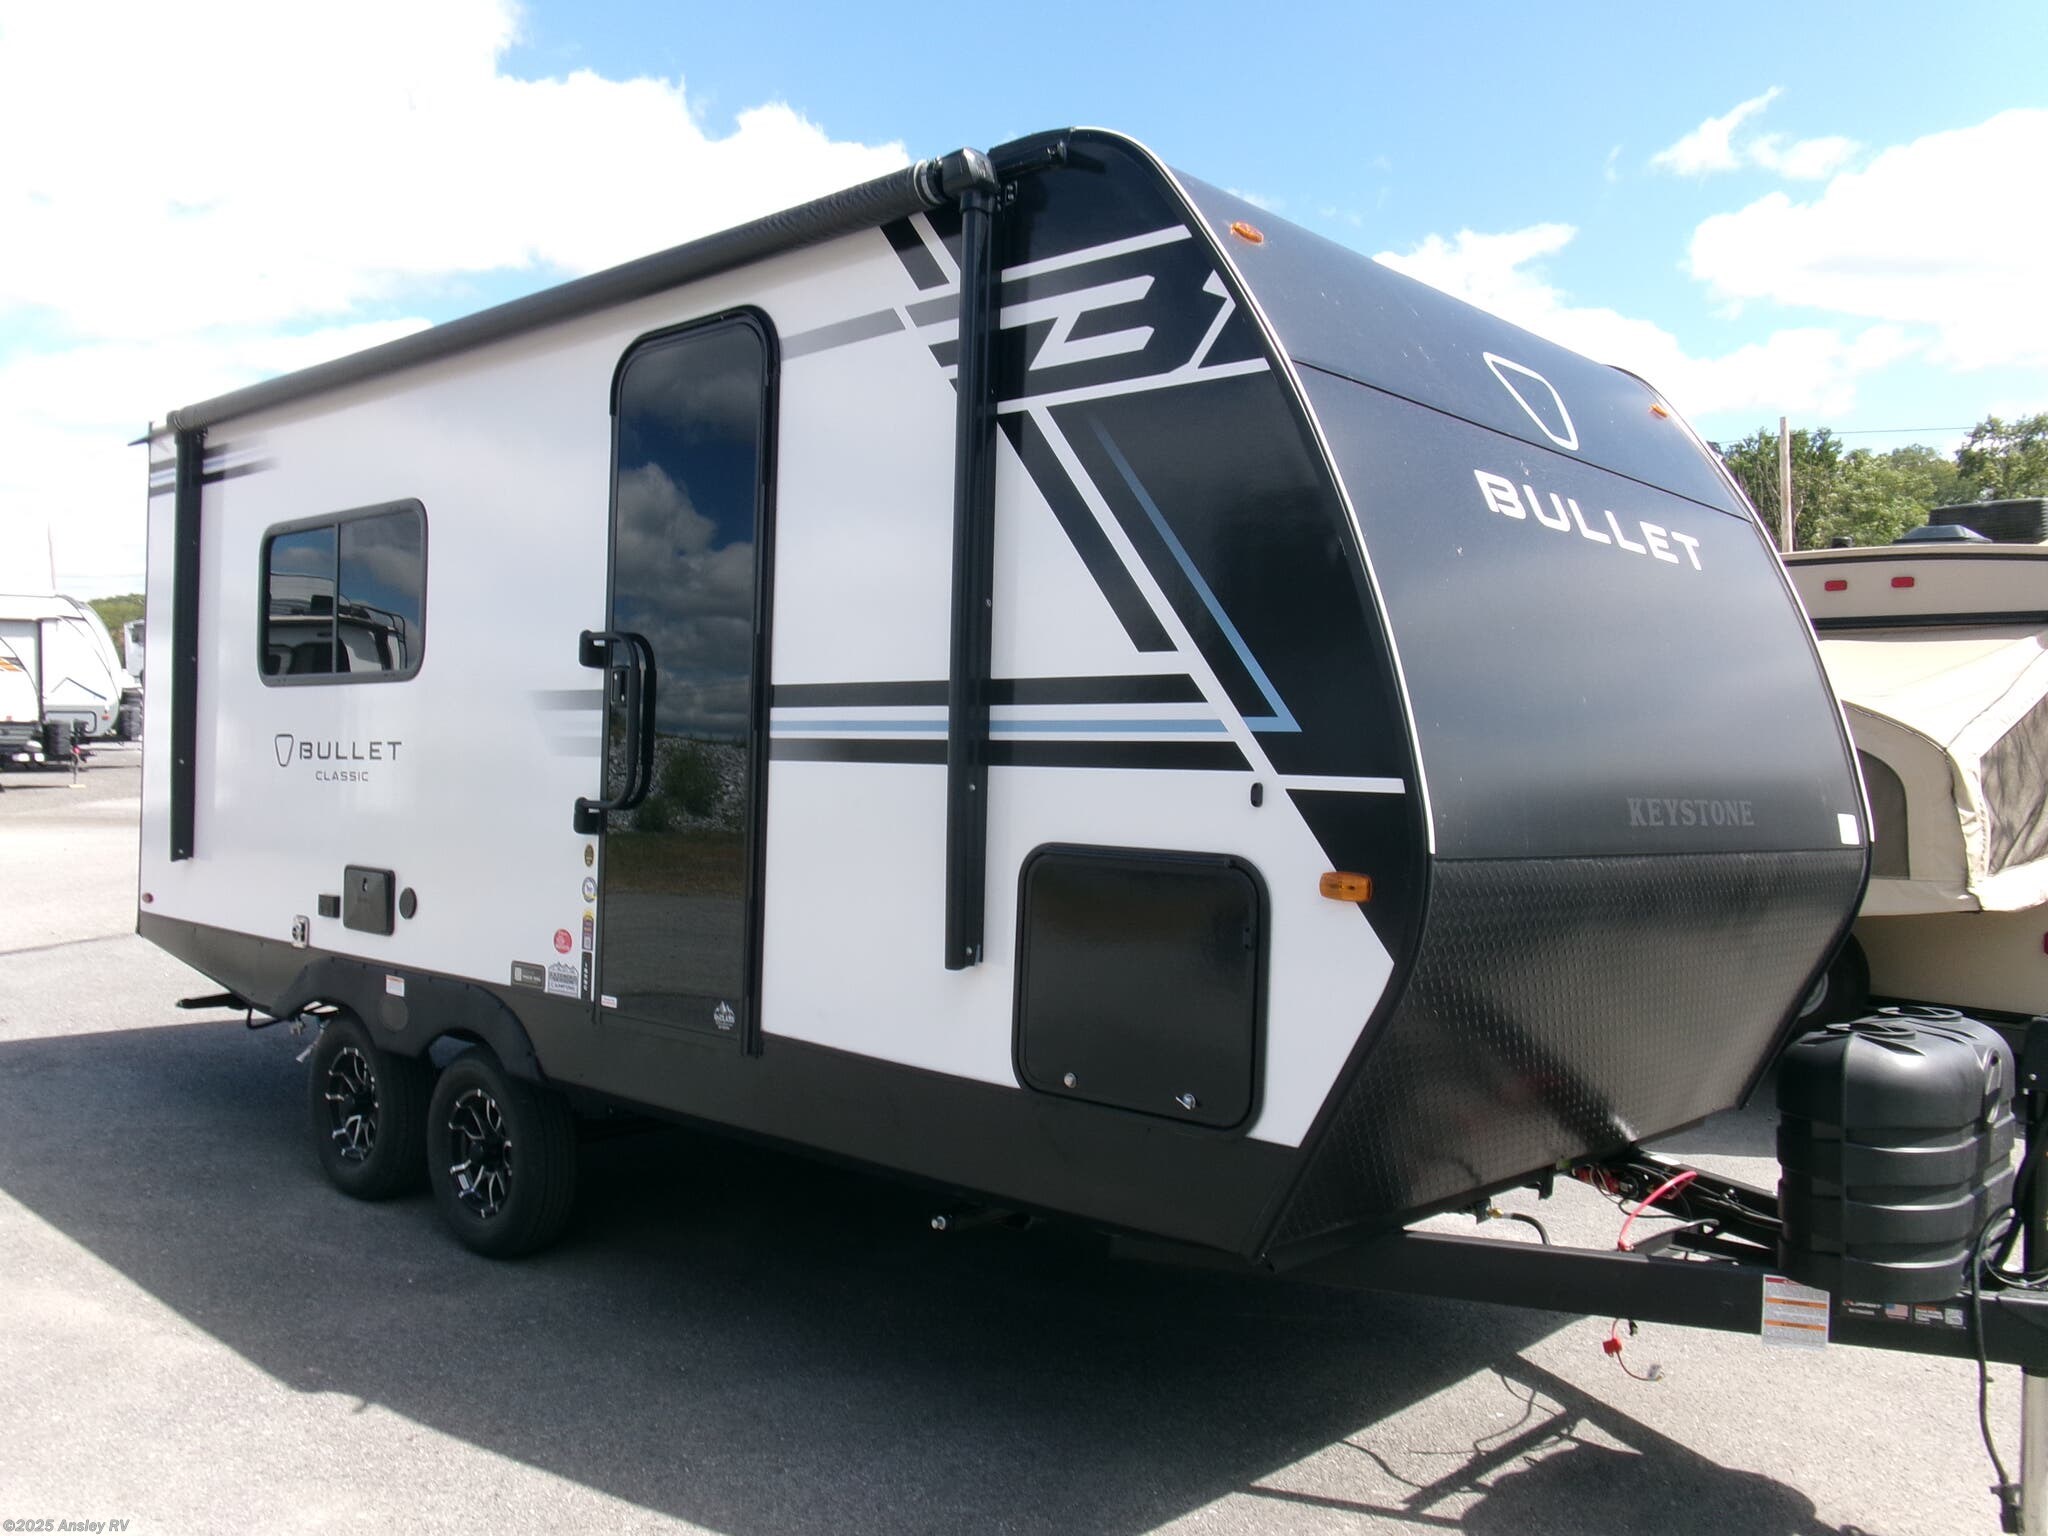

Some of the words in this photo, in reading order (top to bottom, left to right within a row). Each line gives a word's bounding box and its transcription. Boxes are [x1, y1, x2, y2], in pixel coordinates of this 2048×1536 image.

[1474, 469, 1702, 571] BULLET
[299, 741, 402, 761] BULLET
[315, 770, 369, 782] CLASSIC
[1626, 797, 1755, 827] KEYSTONE
